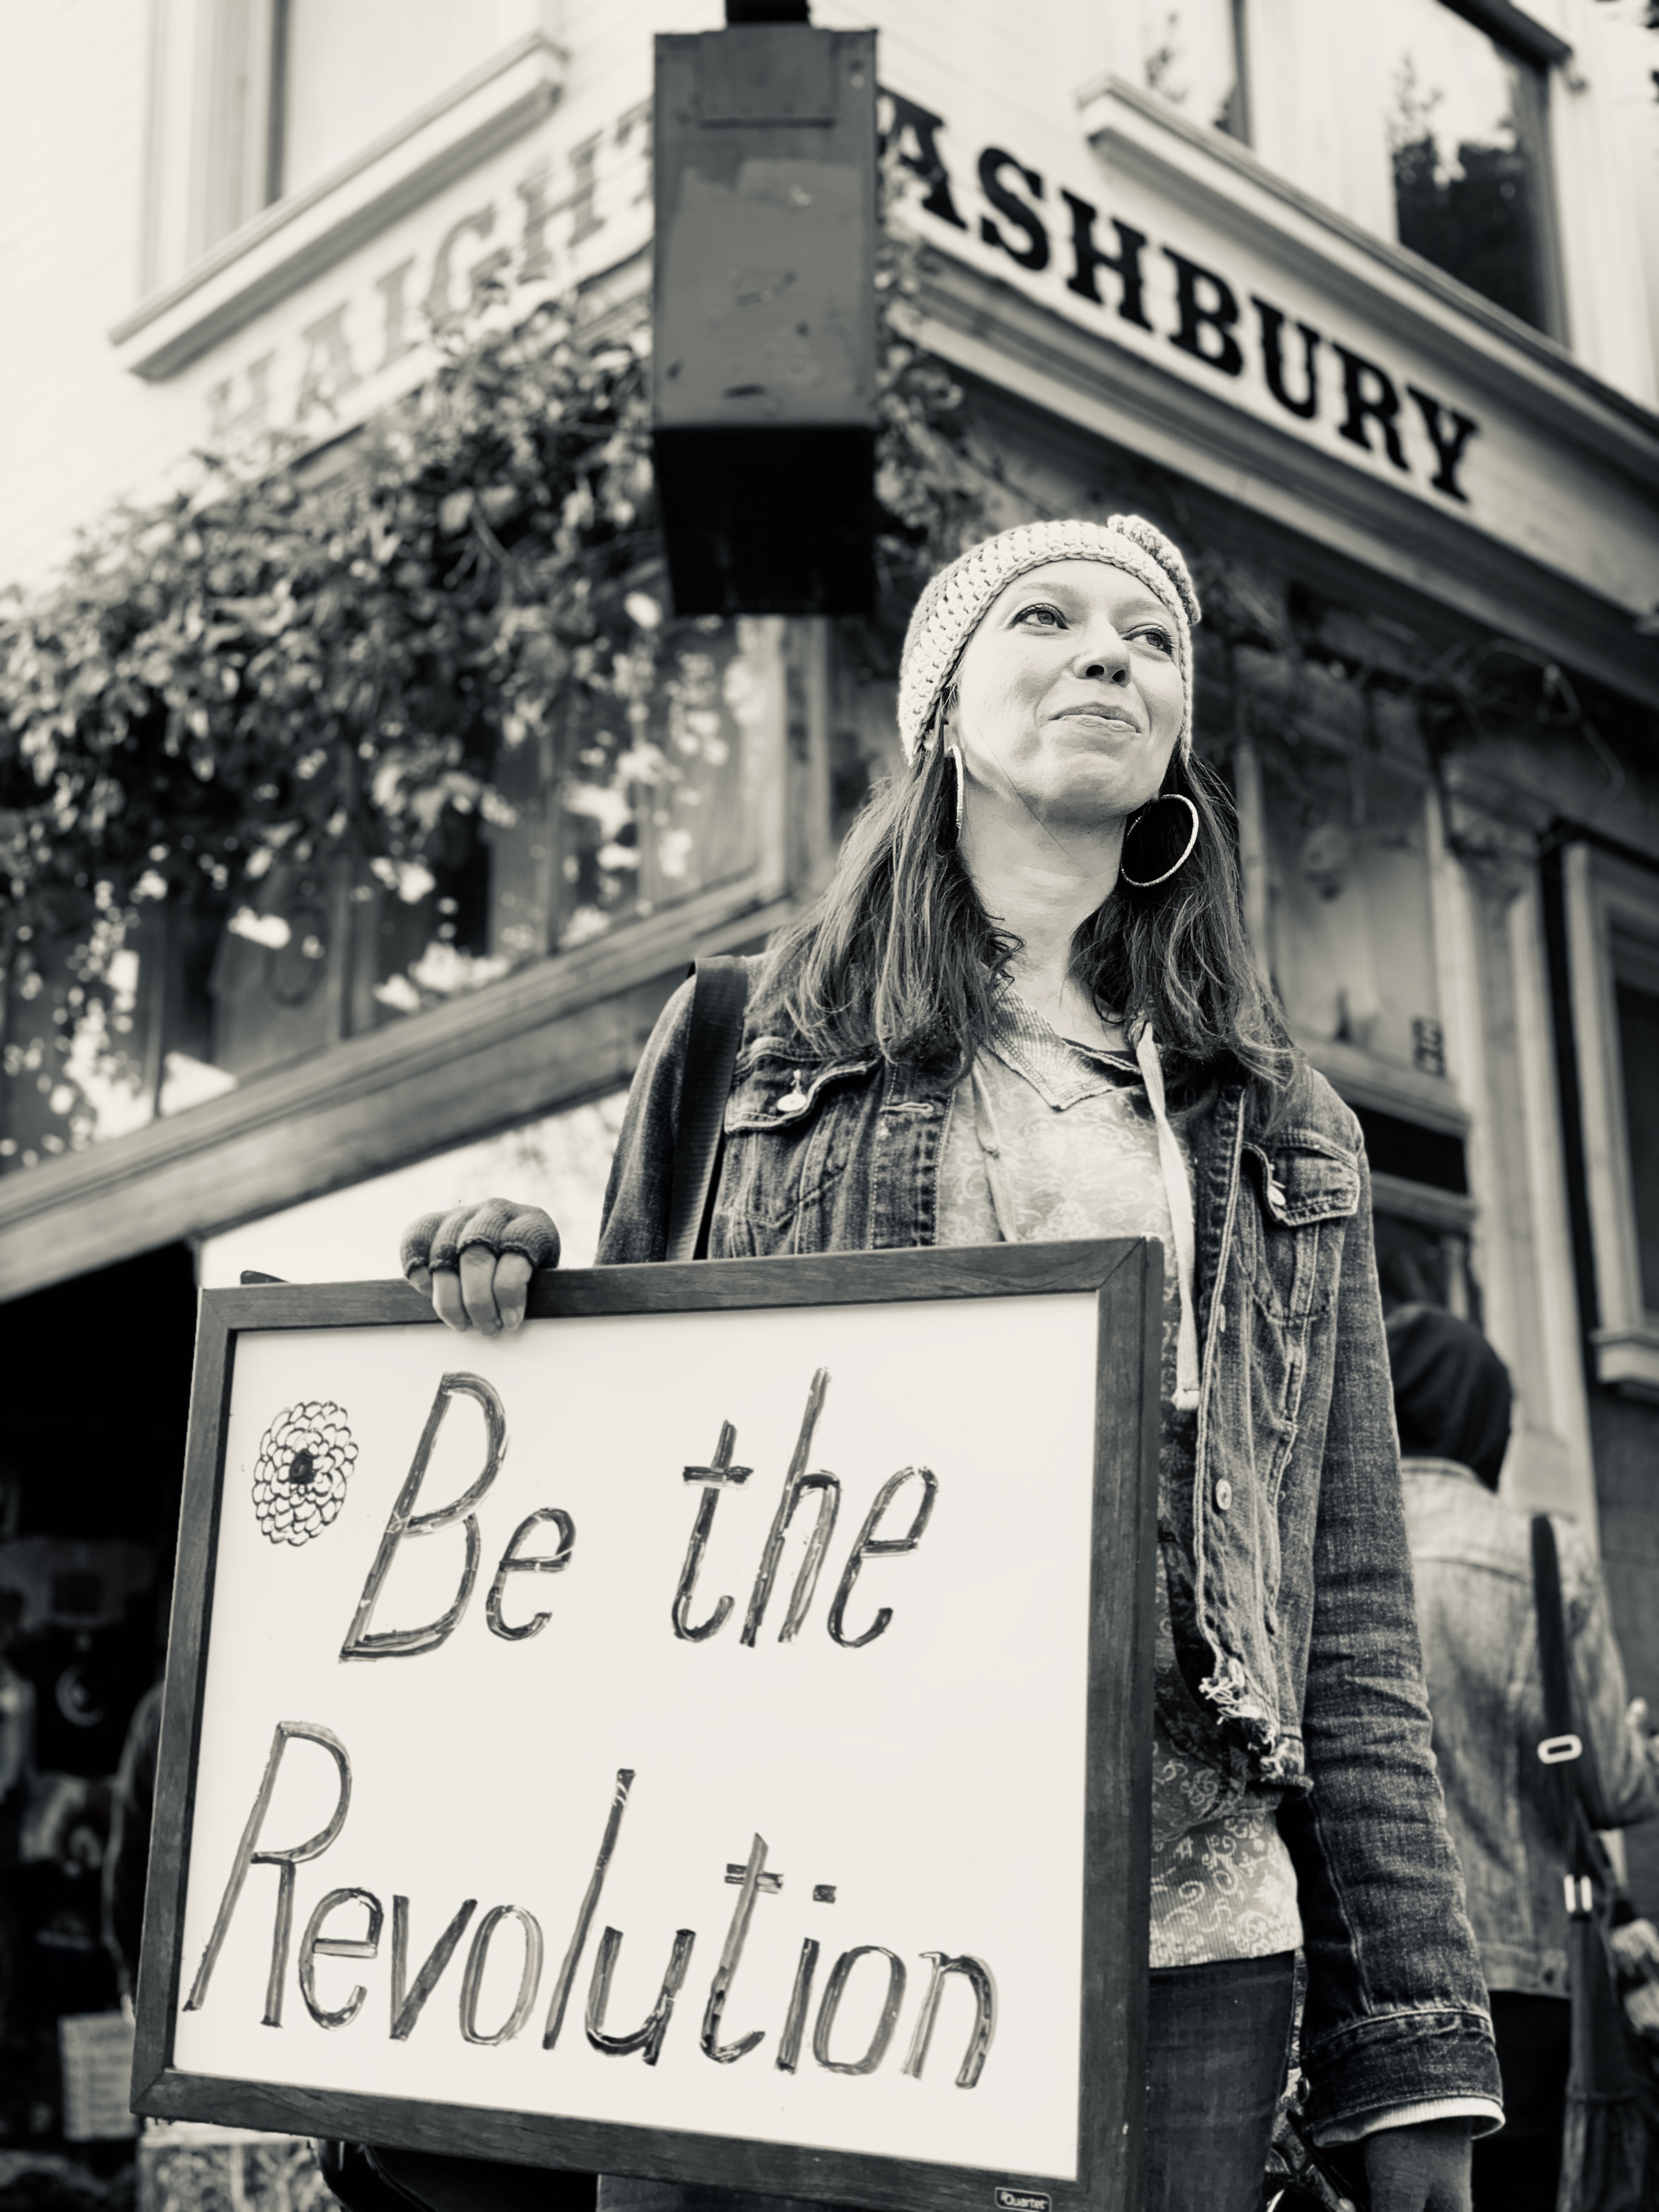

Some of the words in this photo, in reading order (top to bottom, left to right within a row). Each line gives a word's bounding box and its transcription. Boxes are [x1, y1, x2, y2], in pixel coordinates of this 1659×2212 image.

[877, 85, 1480, 505] ASHBURY
[338, 1371, 576, 1663] Be
[670, 1367, 939, 1649] the
[182, 1720, 997, 2090] Revolution
